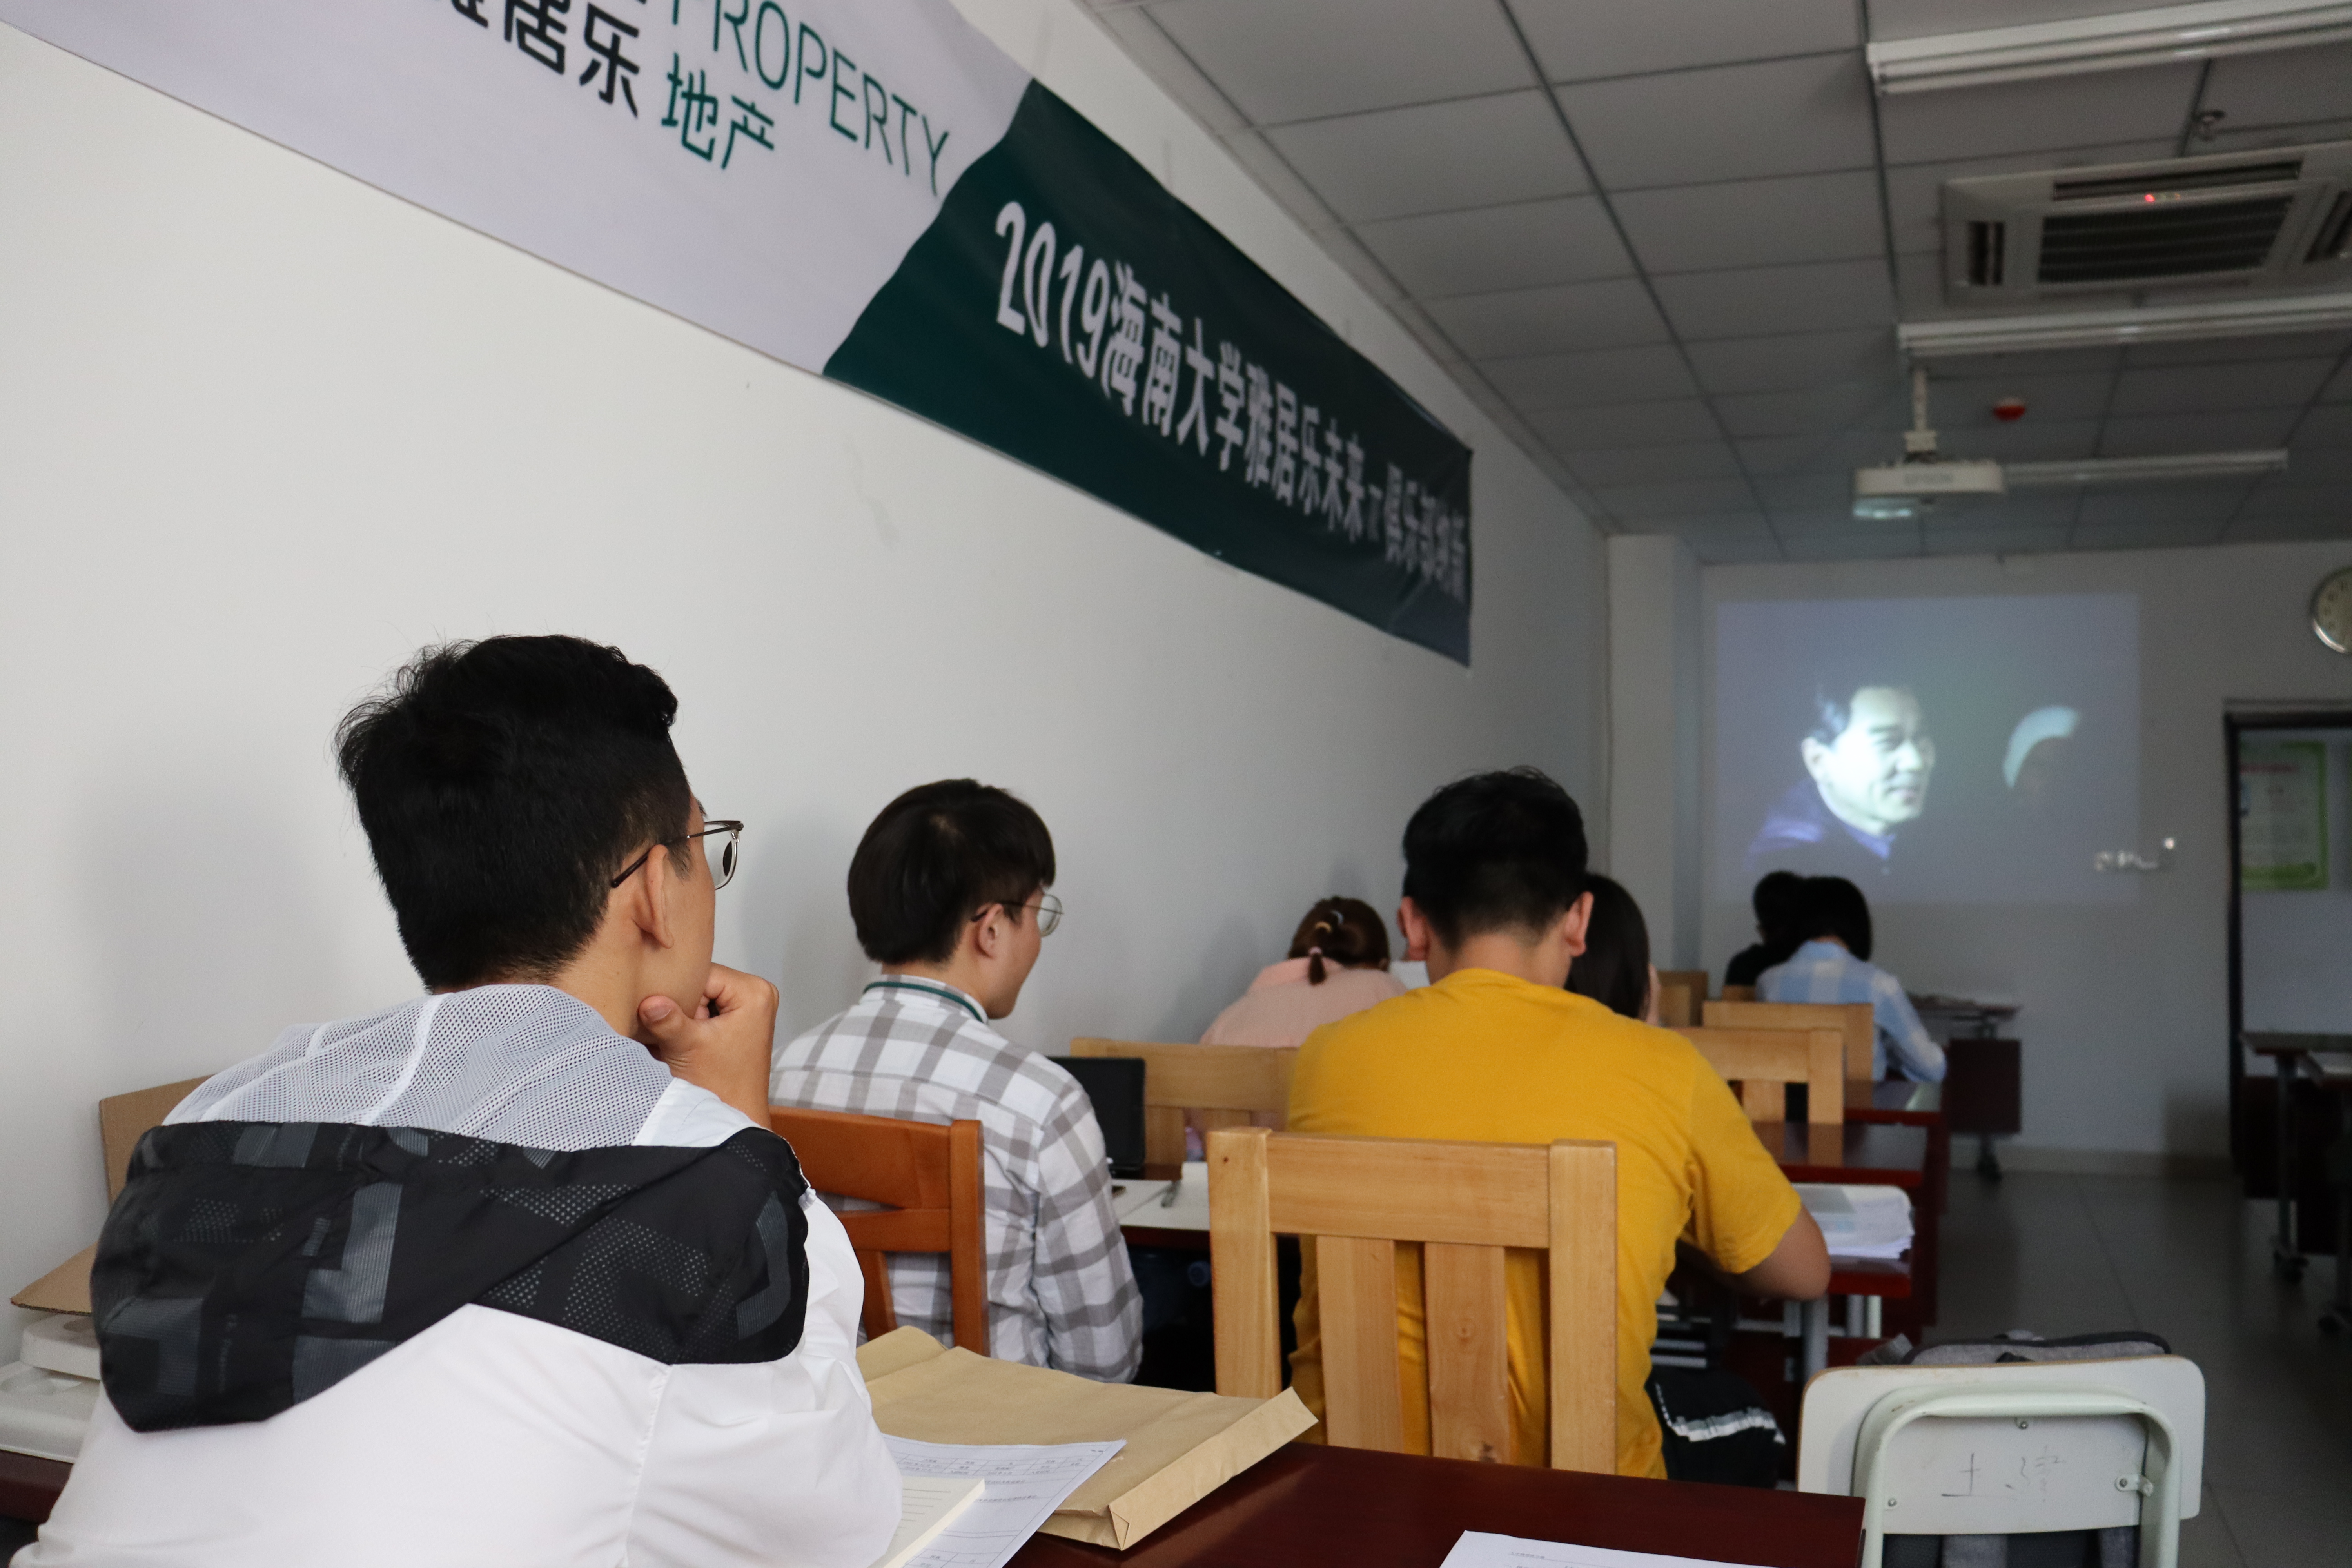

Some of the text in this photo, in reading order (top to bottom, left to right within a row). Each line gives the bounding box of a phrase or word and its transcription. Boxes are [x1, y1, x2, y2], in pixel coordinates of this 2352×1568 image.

[449, 0, 775, 170] 居乐 地产
[673, 0, 949, 197] ROPERTY
